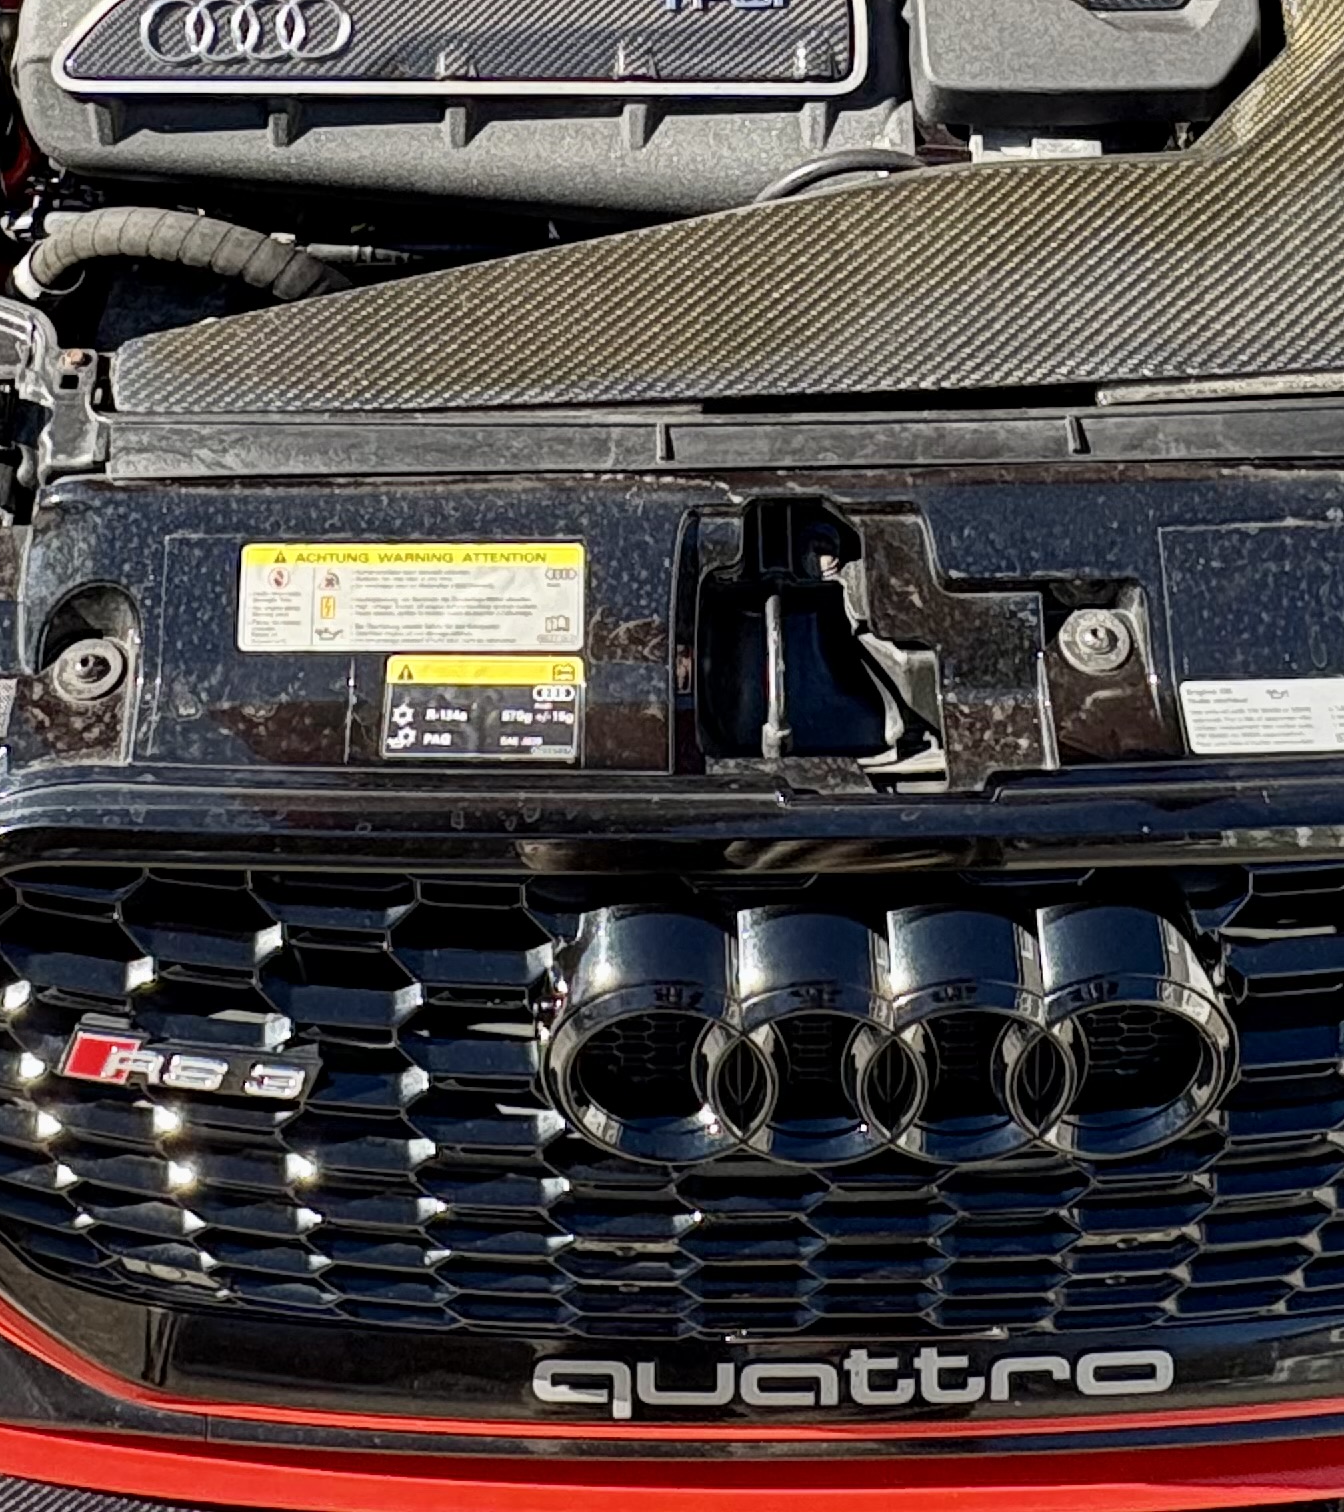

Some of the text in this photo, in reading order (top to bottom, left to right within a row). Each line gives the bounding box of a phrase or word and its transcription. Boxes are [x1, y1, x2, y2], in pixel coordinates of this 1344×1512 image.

[295, 551, 548, 564] ACHTUNG WARNING ATTENTION
[99, 1040, 306, 1100] RS 3
[532, 1346, 1175, 1421] quattro
